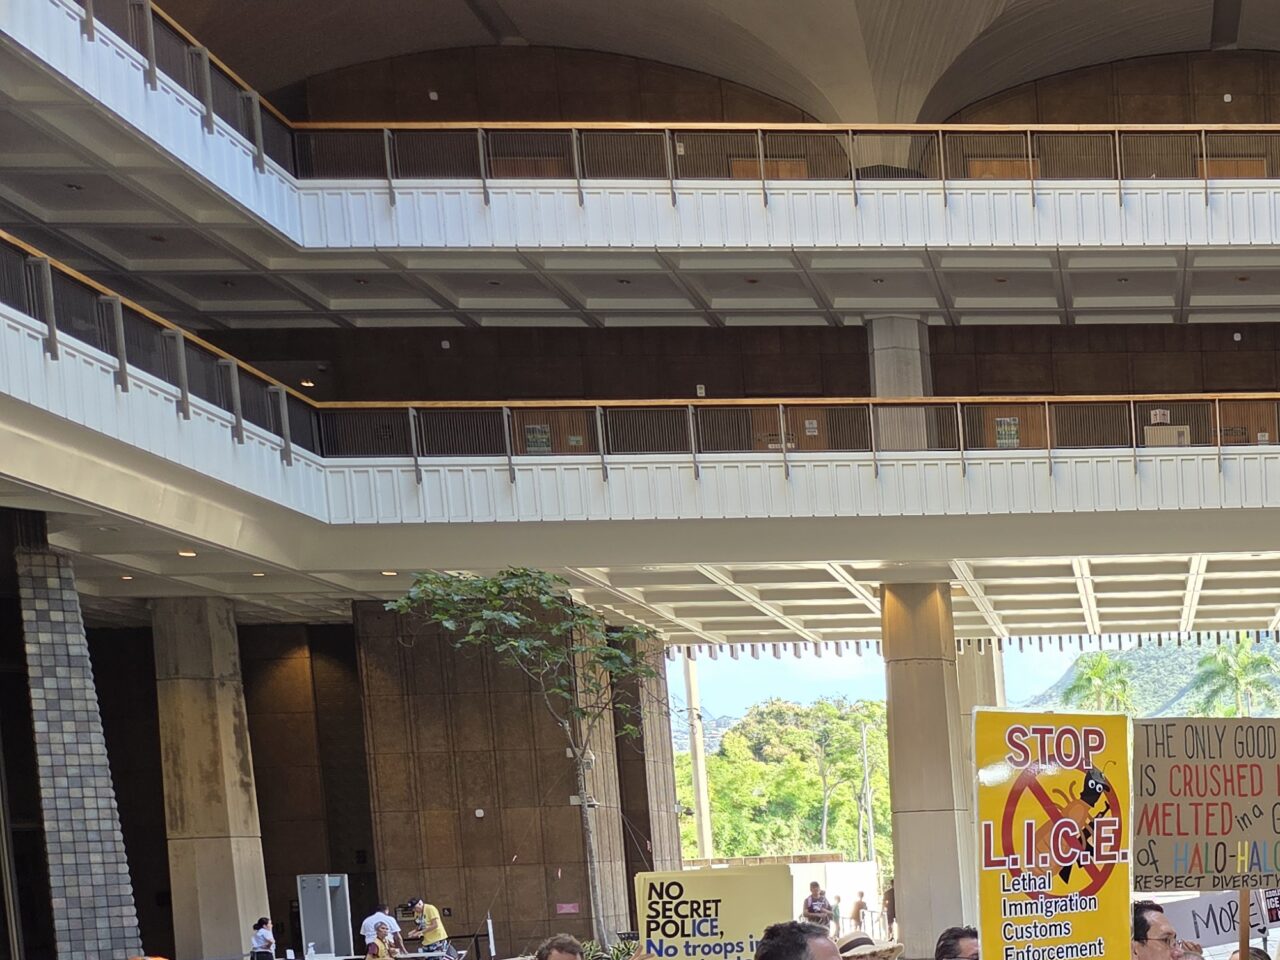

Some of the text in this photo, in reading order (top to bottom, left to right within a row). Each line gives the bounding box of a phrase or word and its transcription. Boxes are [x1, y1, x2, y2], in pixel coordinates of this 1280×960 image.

[1006, 725, 1105, 770] STOP
[1142, 724, 1176, 758] THE
[1184, 725, 1226, 760] ONLY
[1234, 726, 1276, 760] GOOD
[1140, 764, 1156, 797] IS
[1169, 764, 1263, 797] CRUSHED
[1137, 802, 1233, 836] MELTED
[1235, 810, 1252, 831] in
[1252, 803, 1264, 819] a
[982, 818, 1129, 870] L.I.C.E.
[1136, 840, 1159, 873] of
[648, 881, 684, 900] NO
[1001, 872, 1052, 893] Lethal
[1134, 875, 1205, 889] RESPECT
[646, 899, 721, 919] SECRET
[1002, 895, 1098, 918] Immigration
[1267, 897, 1279, 909] ICE
[646, 918, 724, 939] POLICE,
[1003, 920, 1071, 941] Customs
[646, 939, 678, 958] No
[684, 940, 744, 959] troops
